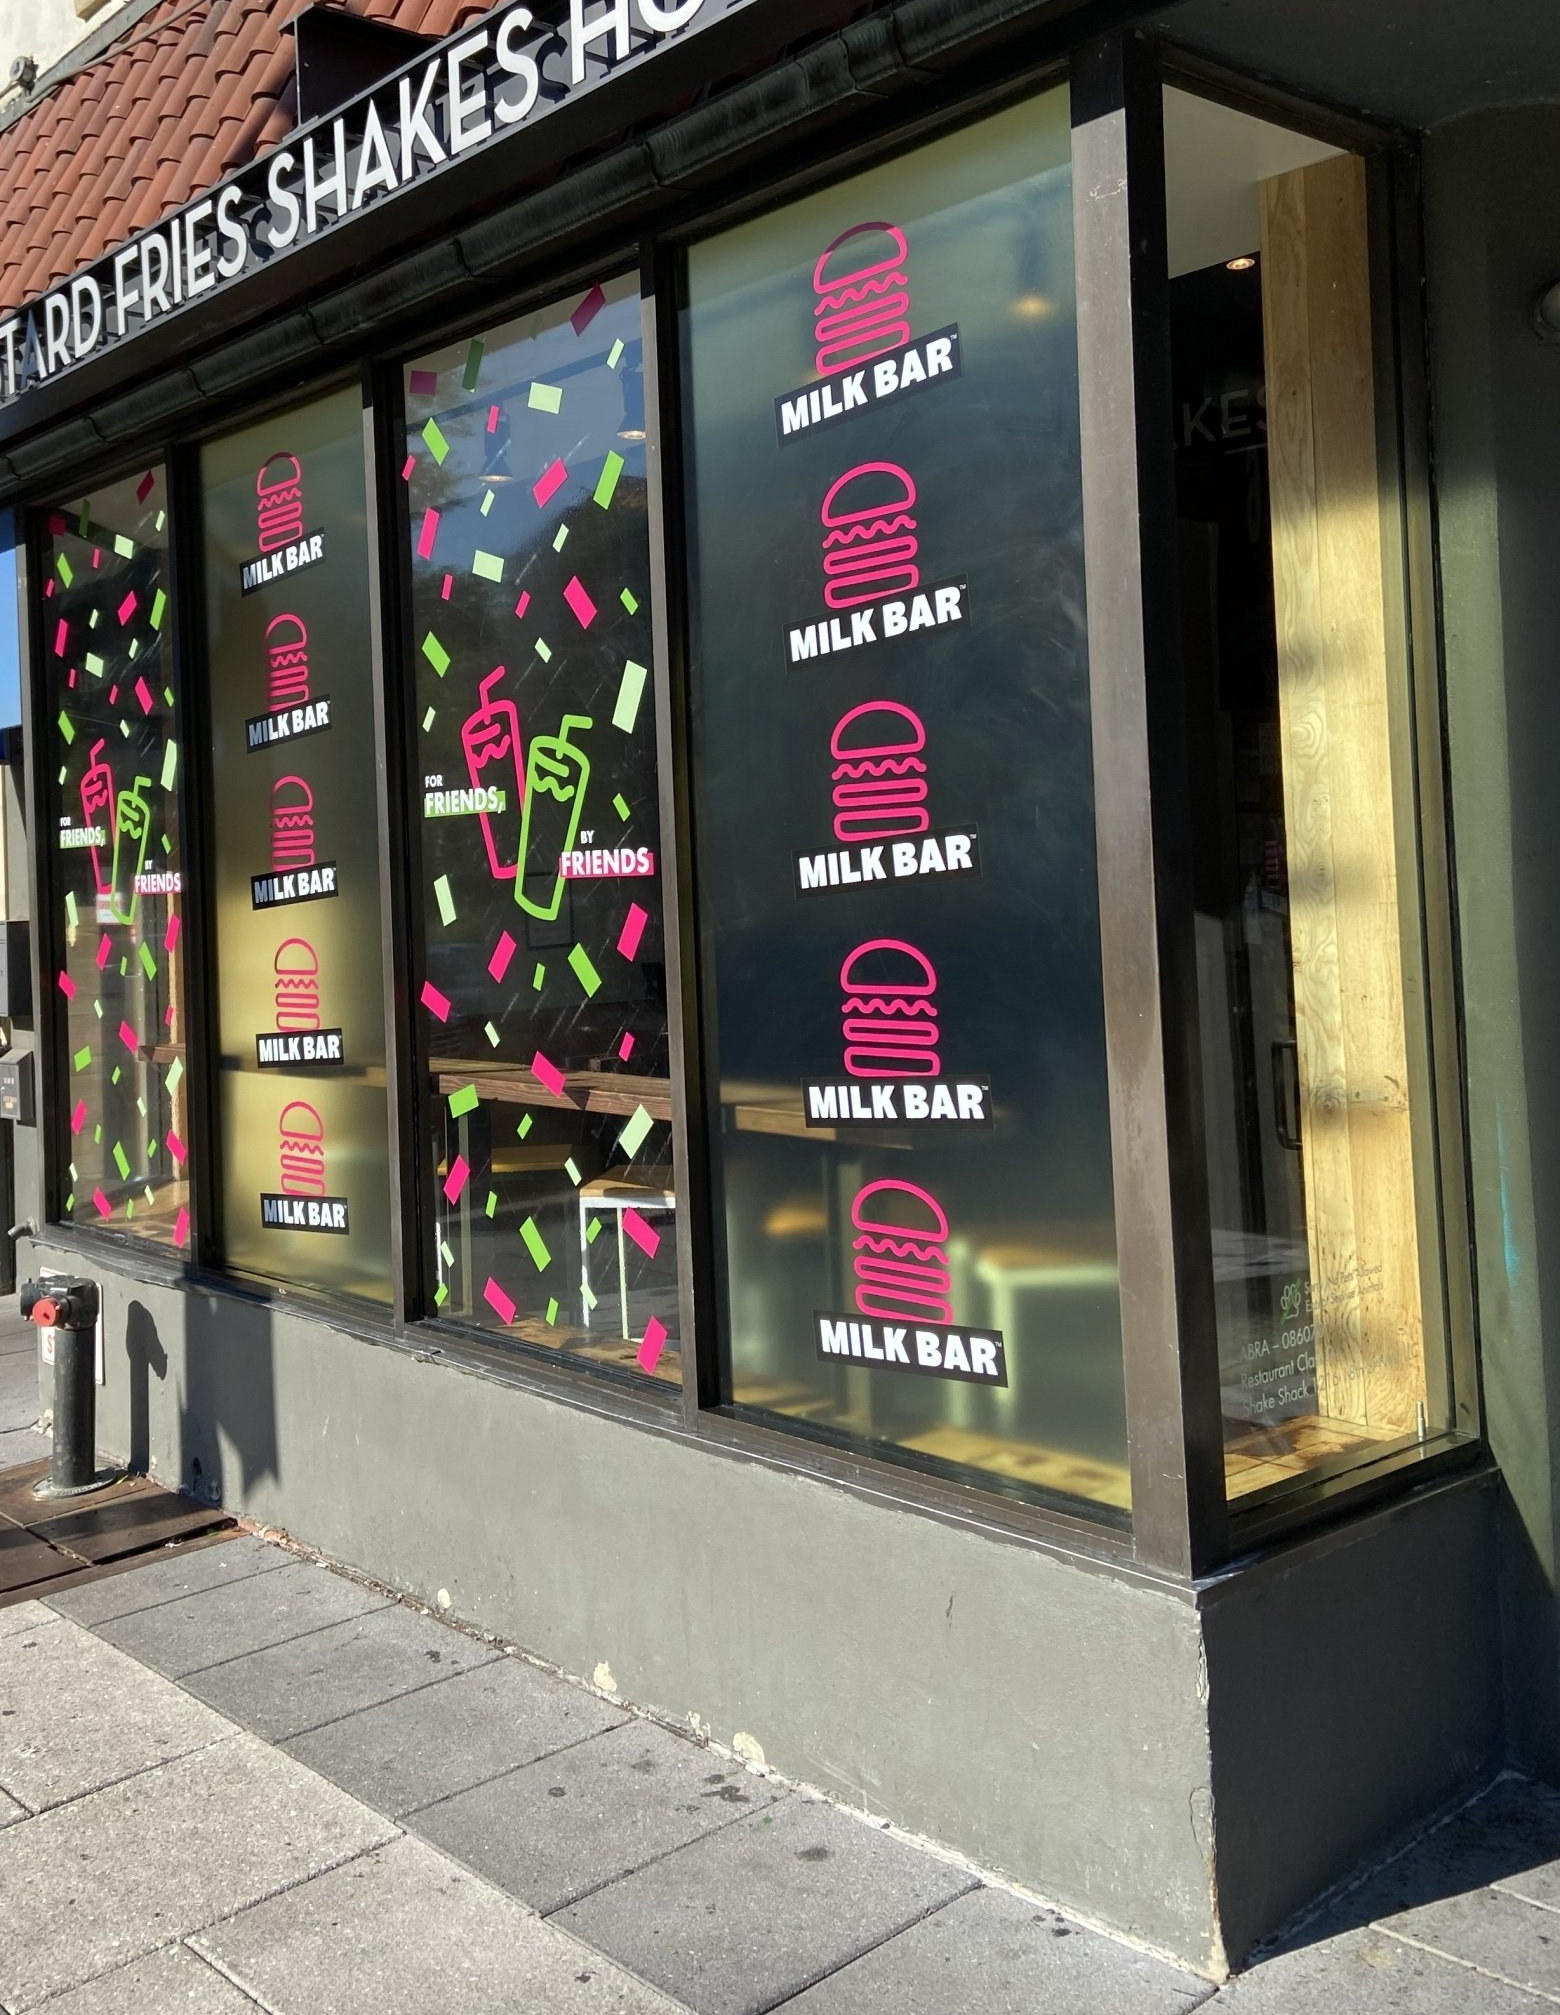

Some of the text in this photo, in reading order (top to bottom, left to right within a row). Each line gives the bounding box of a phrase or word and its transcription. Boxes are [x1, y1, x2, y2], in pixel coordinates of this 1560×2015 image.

[0, 275, 101, 395] TARD
[115, 186, 247, 336] FRIES
[268, 8, 539, 248] SHAKES
[781, 370, 868, 435] MILK
[243, 551, 285, 590] MILK
[790, 608, 877, 663] MILK
[248, 713, 290, 747] MILK
[425, 774, 443, 788] FOR
[425, 786, 504, 815] FRIENDS,
[60, 816, 71, 827] FOR
[580, 830, 595, 844] BY
[144, 860, 153, 871] BY
[561, 847, 650, 876] FRIENDS
[799, 846, 887, 889] MILK
[134, 872, 182, 893] FRIENDS
[254, 874, 295, 904] MILK
[258, 1036, 301, 1063] MILK
[809, 1085, 898, 1119] MILK
[263, 1199, 306, 1225] MILK
[820, 1319, 910, 1364] MILK
[1240, 1339, 1271, 1361] ABRA
[1241, 1360, 1295, 1391] Restaurant
[1243, 1392, 1275, 1418] Shake
[1278, 1379, 1309, 1406] Shack
